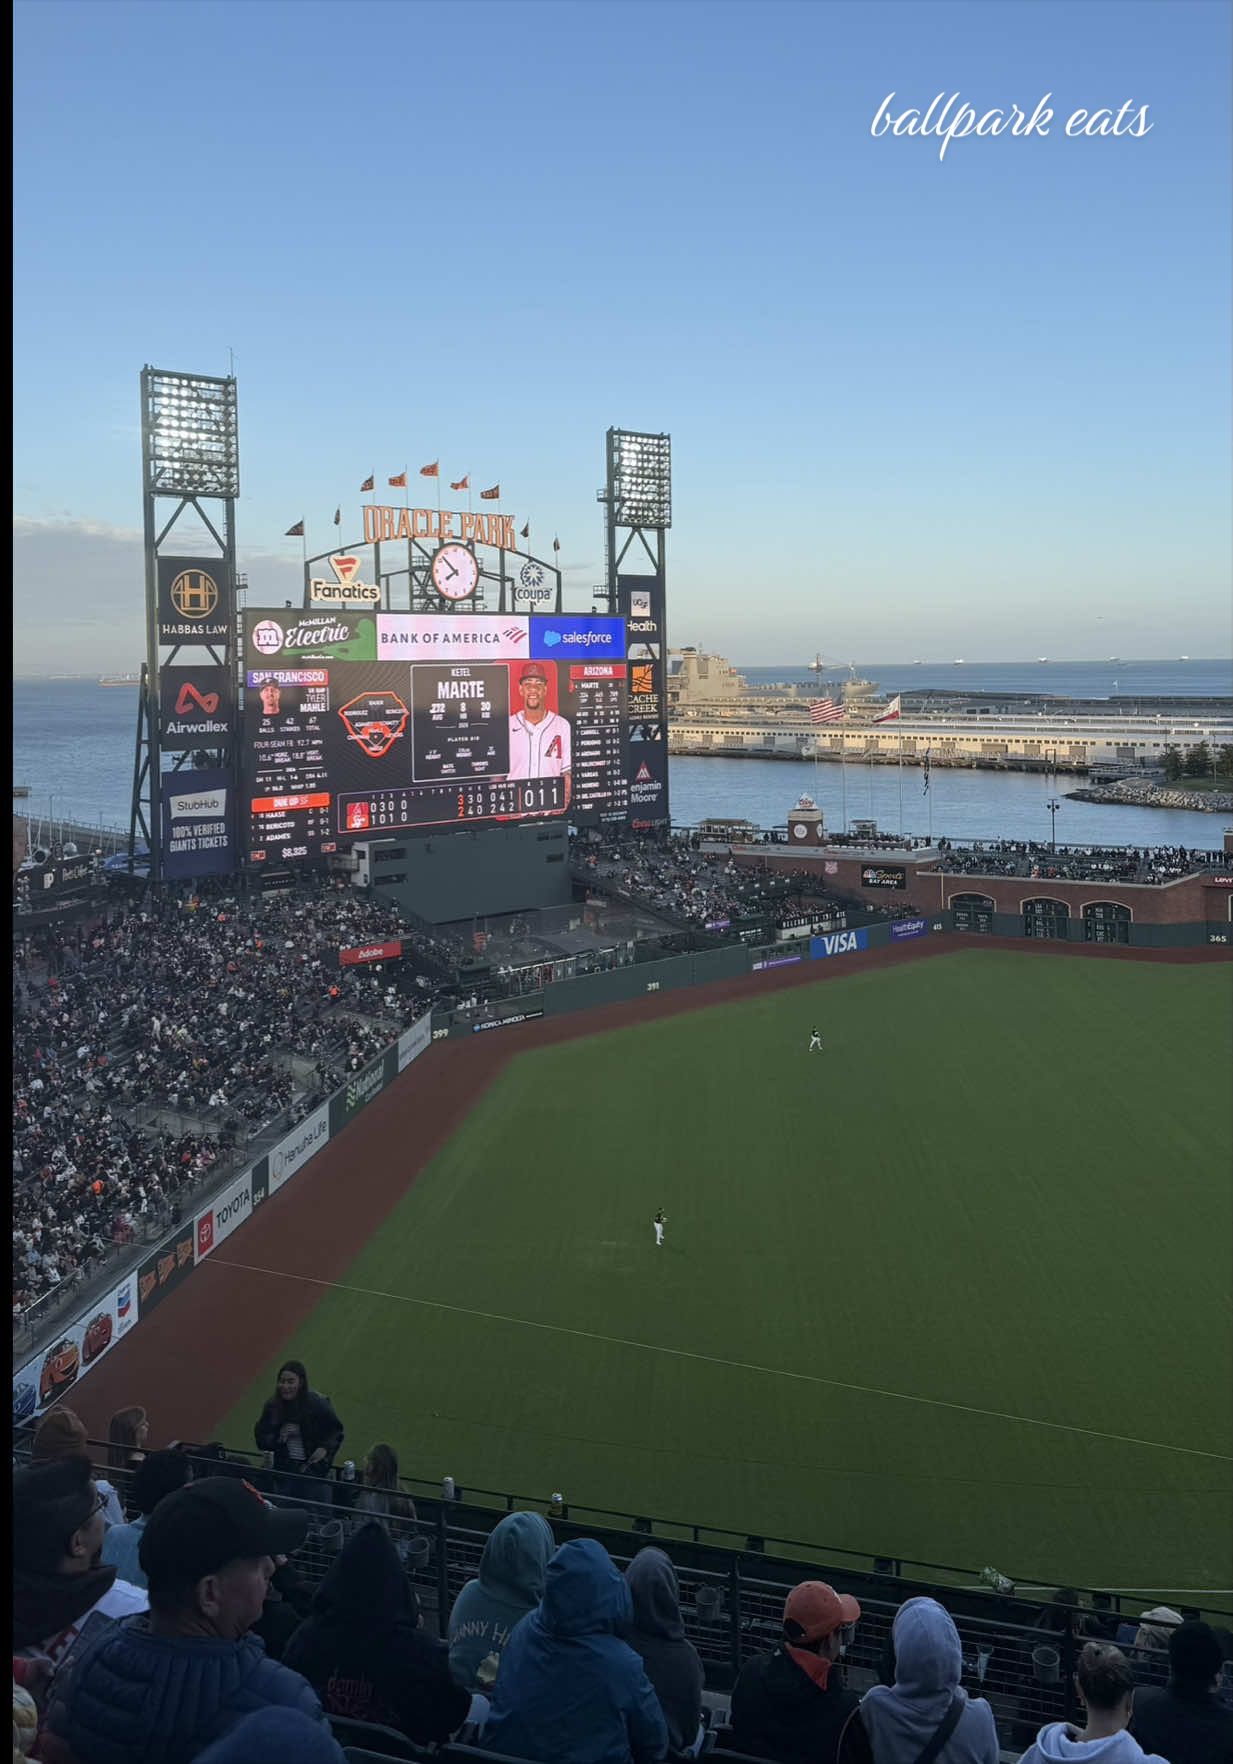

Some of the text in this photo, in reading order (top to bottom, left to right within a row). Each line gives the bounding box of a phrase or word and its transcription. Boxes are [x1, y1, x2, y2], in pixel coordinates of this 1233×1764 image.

[363, 505, 517, 551] ORACLE PARK
[312, 580, 378, 599] Fanatics
[516, 587, 550, 602] coupa
[163, 624, 227, 634] HABBAS LAW
[285, 624, 349, 648] Electric
[381, 633, 500, 643] BANK OF AMERICA
[562, 632, 612, 647] salesforce
[273, 671, 325, 683] FRANCISCO
[583, 666, 614, 676] ARIZONA
[437, 681, 485, 699] MARTE
[300, 703, 326, 712] MAHLE
[166, 720, 228, 735] Airwallex
[631, 780, 661, 794] enjamin
[524, 787, 557, 807] 0 1 1
[177, 800, 219, 811] StubHub
[370, 803, 376, 813] 0
[380, 802, 386, 812] 3
[389, 801, 394, 811] 0
[401, 800, 407, 810] 0
[371, 814, 376, 825] 1
[380, 814, 386, 824] 0
[389, 813, 393, 823] 1
[401, 812, 407, 822] 0
[172, 822, 226, 838] 100% VERIFIED
[266, 833, 291, 841] ADAMES
[170, 835, 229, 852] GIANTS TICKETS
[821, 931, 857, 955] VISA
[1210, 935, 1227, 943] 365
[358, 948, 384, 959] Adobe
[433, 1028, 448, 1039] 399
[216, 1188, 250, 1228] TOYOTA
